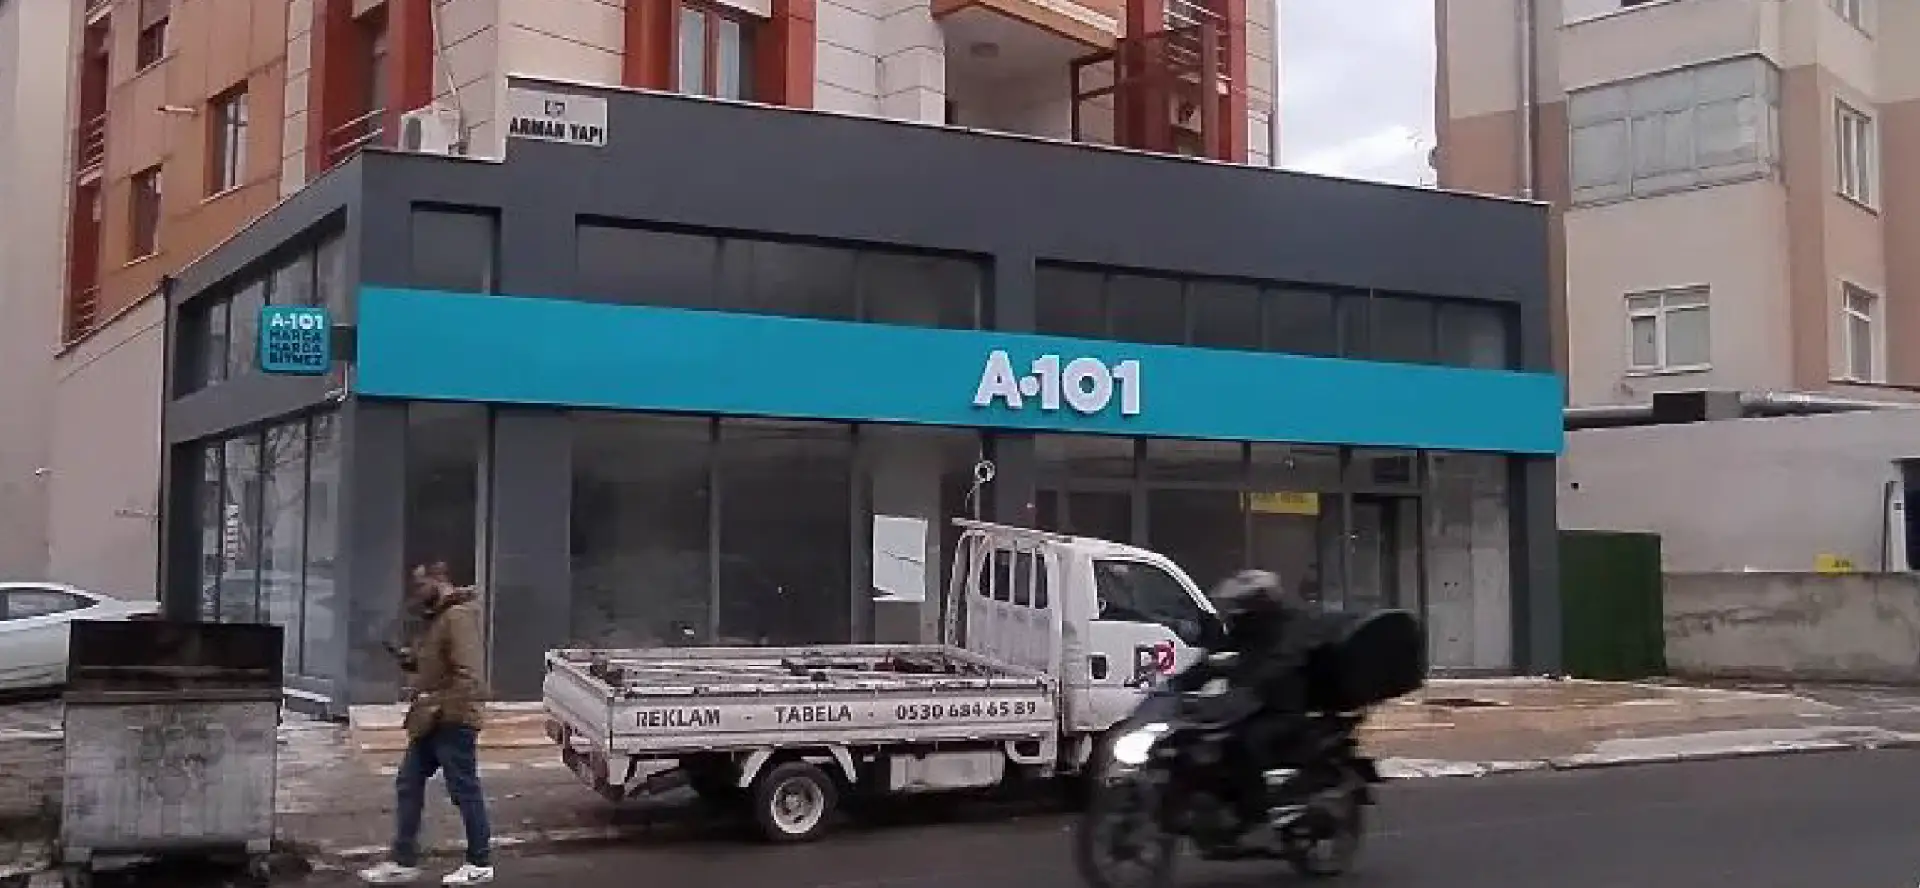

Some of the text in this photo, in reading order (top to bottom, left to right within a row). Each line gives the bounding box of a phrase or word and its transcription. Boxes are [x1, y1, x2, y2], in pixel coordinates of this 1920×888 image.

[509, 117, 603, 143] ARMAN YAPI
[636, 708, 720, 727] REKLAM
[774, 704, 852, 724] TABELA
[896, 704, 944, 720] 0530
